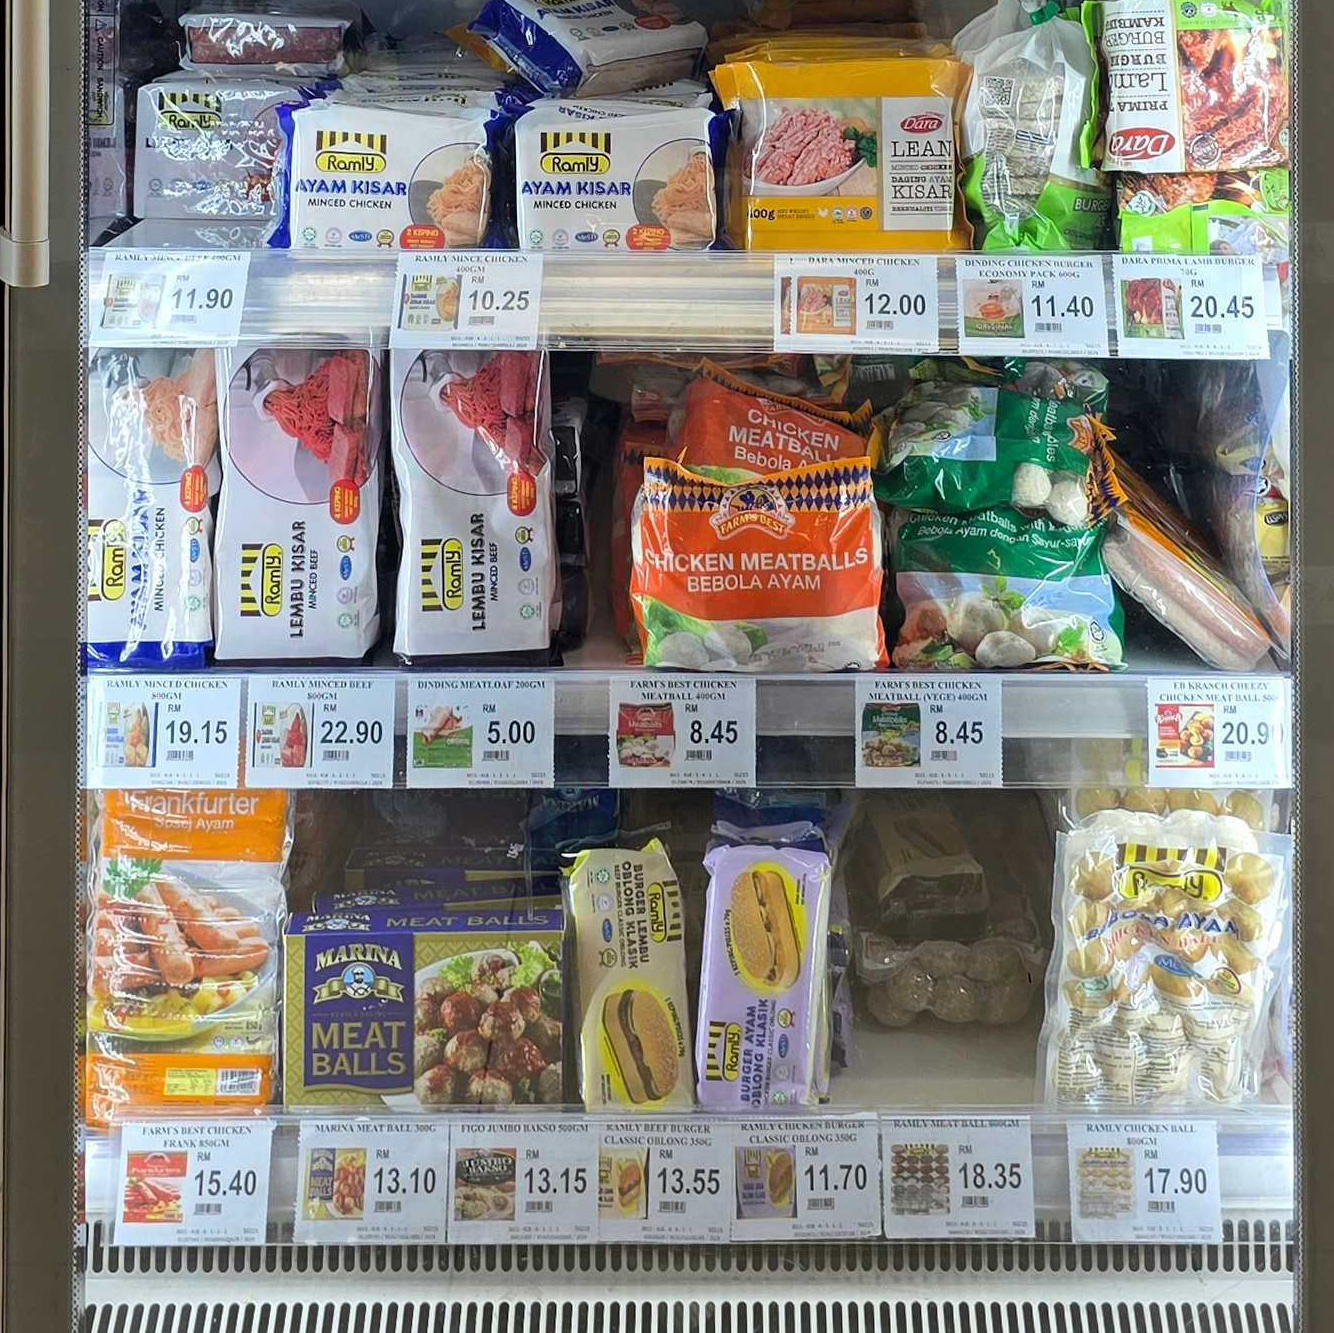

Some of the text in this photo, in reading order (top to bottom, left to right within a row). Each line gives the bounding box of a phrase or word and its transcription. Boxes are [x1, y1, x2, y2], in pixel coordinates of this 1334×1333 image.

[907, 116, 939, 130] Dara
[891, 140, 951, 156] LEAN
[893, 183, 952, 199] KISAR
[172, 288, 233, 311] 11.90
[468, 290, 529, 311] 10.25
[1032, 295, 1094, 317] 11.40
[1190, 296, 1254, 318] 20.45
[645, 546, 868, 571] CHICKEN MEATBALLS
[290, 521, 306, 639] LEMBU KISAR
[687, 573, 821, 593] BEBOLA AYAM
[166, 720, 228, 744] 19.15
[320, 720, 383, 744] 22.90
[487, 720, 535, 744] 5.00
[690, 721, 738, 745] 8.45
[131, 792, 259, 816] Frankfurter
[314, 945, 402, 972] MARINA
[312, 1023, 405, 1048] MEAT
[312, 1053, 406, 1074] BALLS
[315, 1124, 436, 1133] MARINA MEAT BALL 300G
[194, 1171, 256, 1196] 15.40
[374, 1168, 436, 1193] 13.10
[524, 1168, 587, 1194] 13.15
[803, 1165, 867, 1191] 11.70
[957, 1163, 1021, 1189] 18.35
[1144, 1168, 1207, 1195] 17.90
